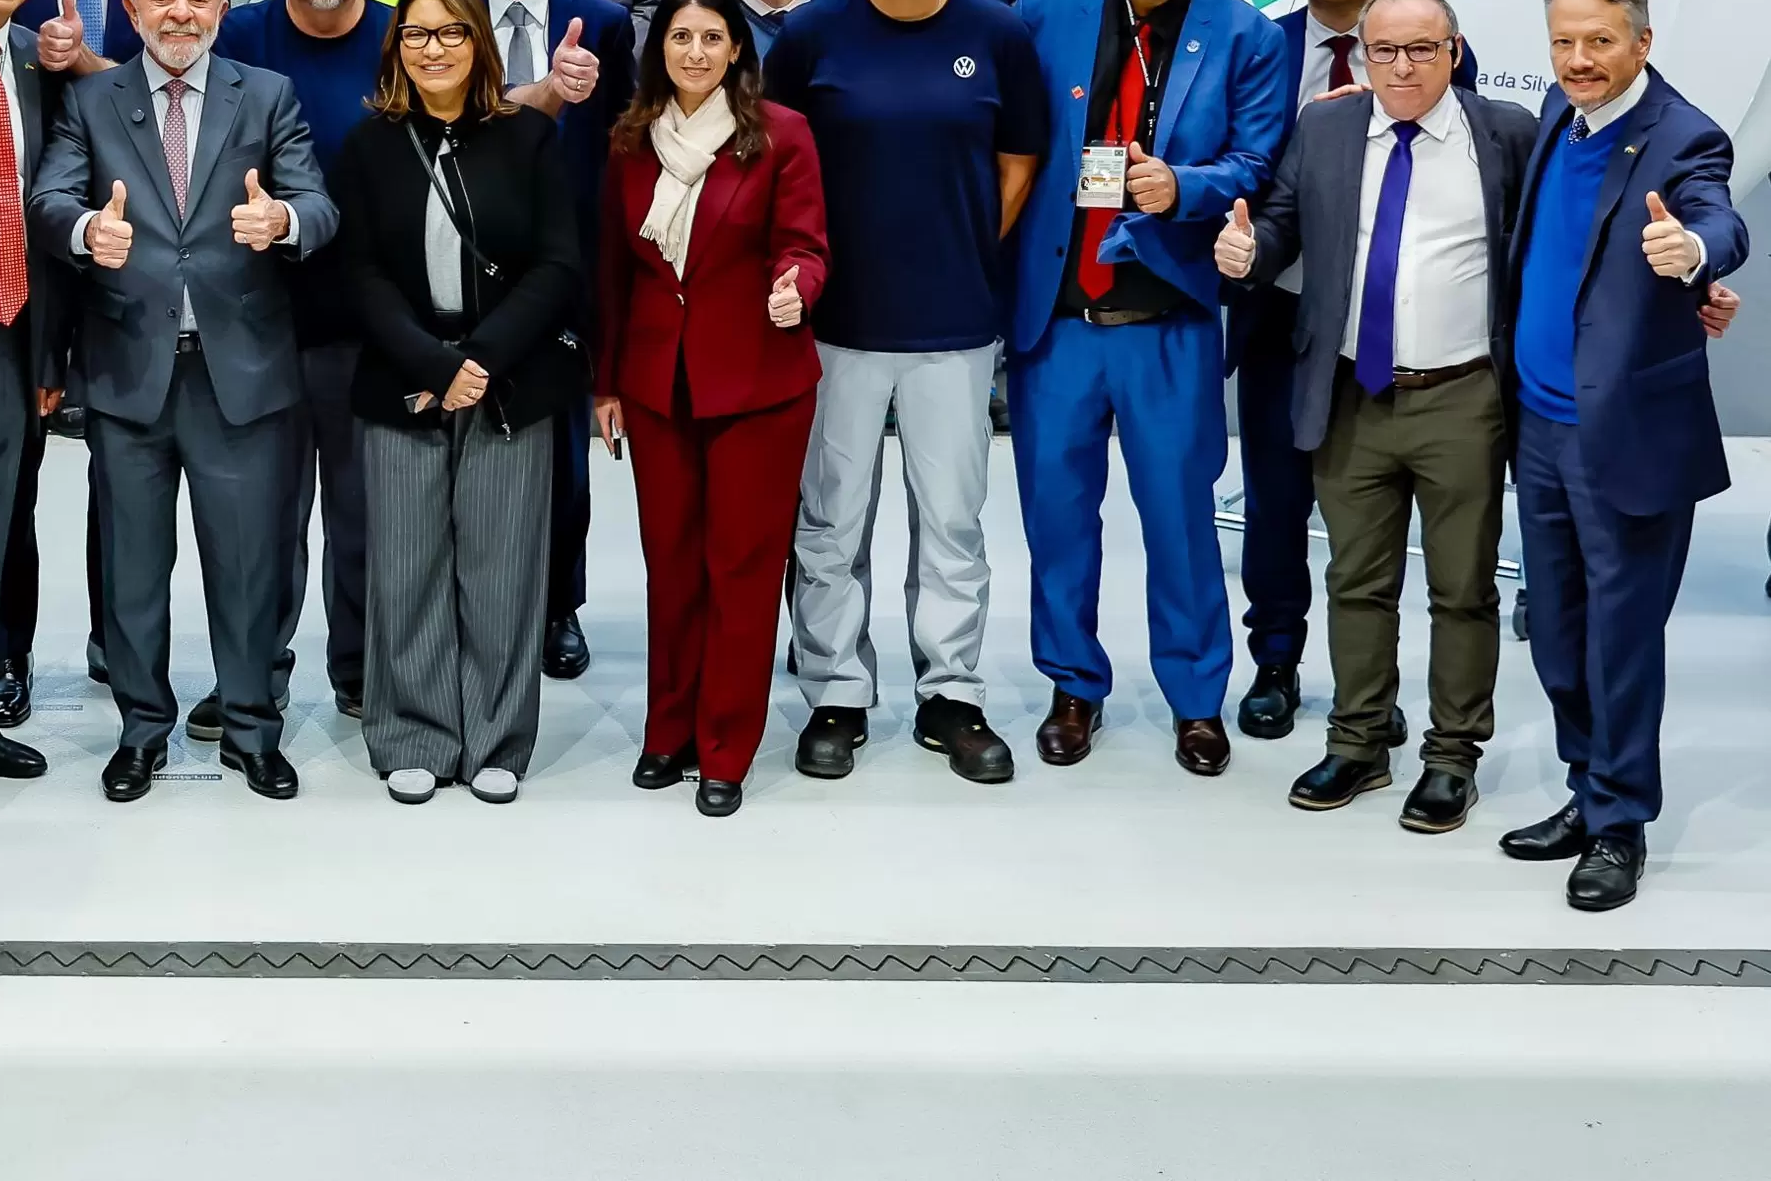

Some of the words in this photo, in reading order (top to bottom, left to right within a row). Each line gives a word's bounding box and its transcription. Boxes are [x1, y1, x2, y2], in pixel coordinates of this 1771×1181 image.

[953, 56, 975, 78] VW
[1493, 71, 1516, 89] da
[1520, 74, 1550, 92] Silv
